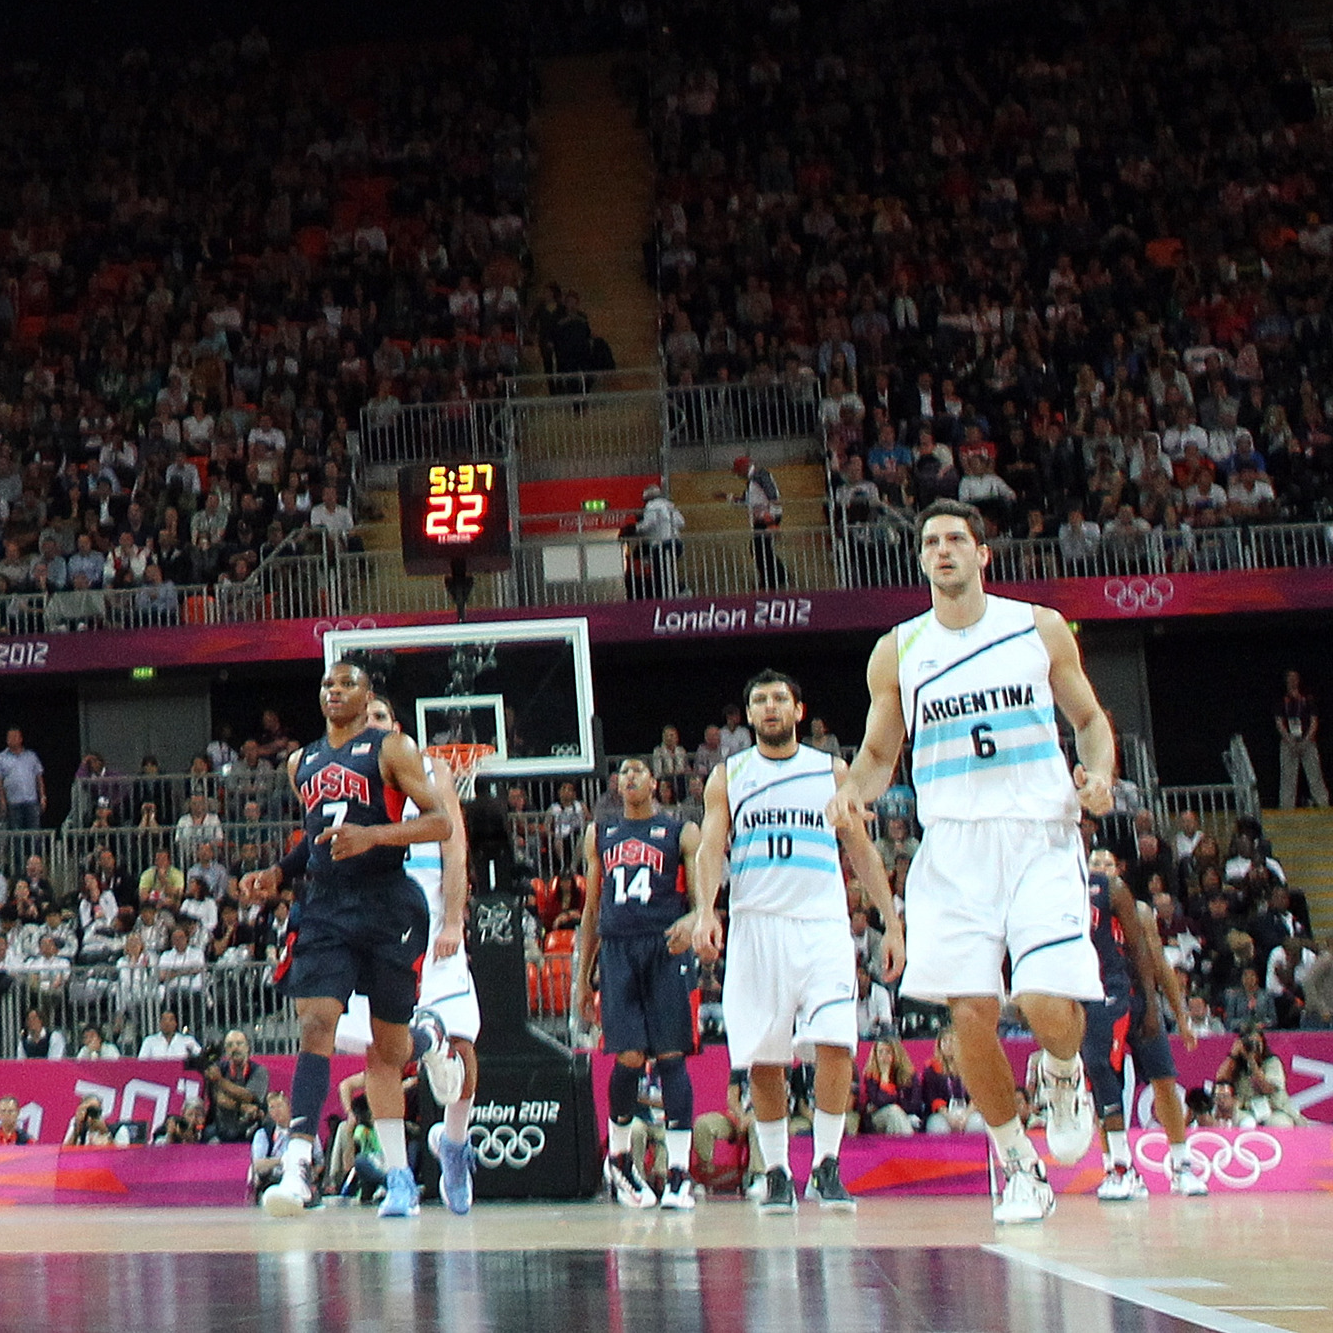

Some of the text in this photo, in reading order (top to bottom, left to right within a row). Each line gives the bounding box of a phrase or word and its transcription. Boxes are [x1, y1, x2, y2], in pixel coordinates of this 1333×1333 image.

[428, 462, 495, 495] 5:37
[425, 494, 486, 538] 22
[653, 597, 812, 635] London 2012
[921, 683, 1035, 724] ARGENTINA
[970, 722, 997, 759] 6
[300, 762, 371, 813] USA
[322, 800, 349, 829] 7
[603, 838, 665, 877] USA
[767, 831, 794, 860] 10
[612, 866, 653, 905] 14
[518, 1100, 561, 1124] 2012
